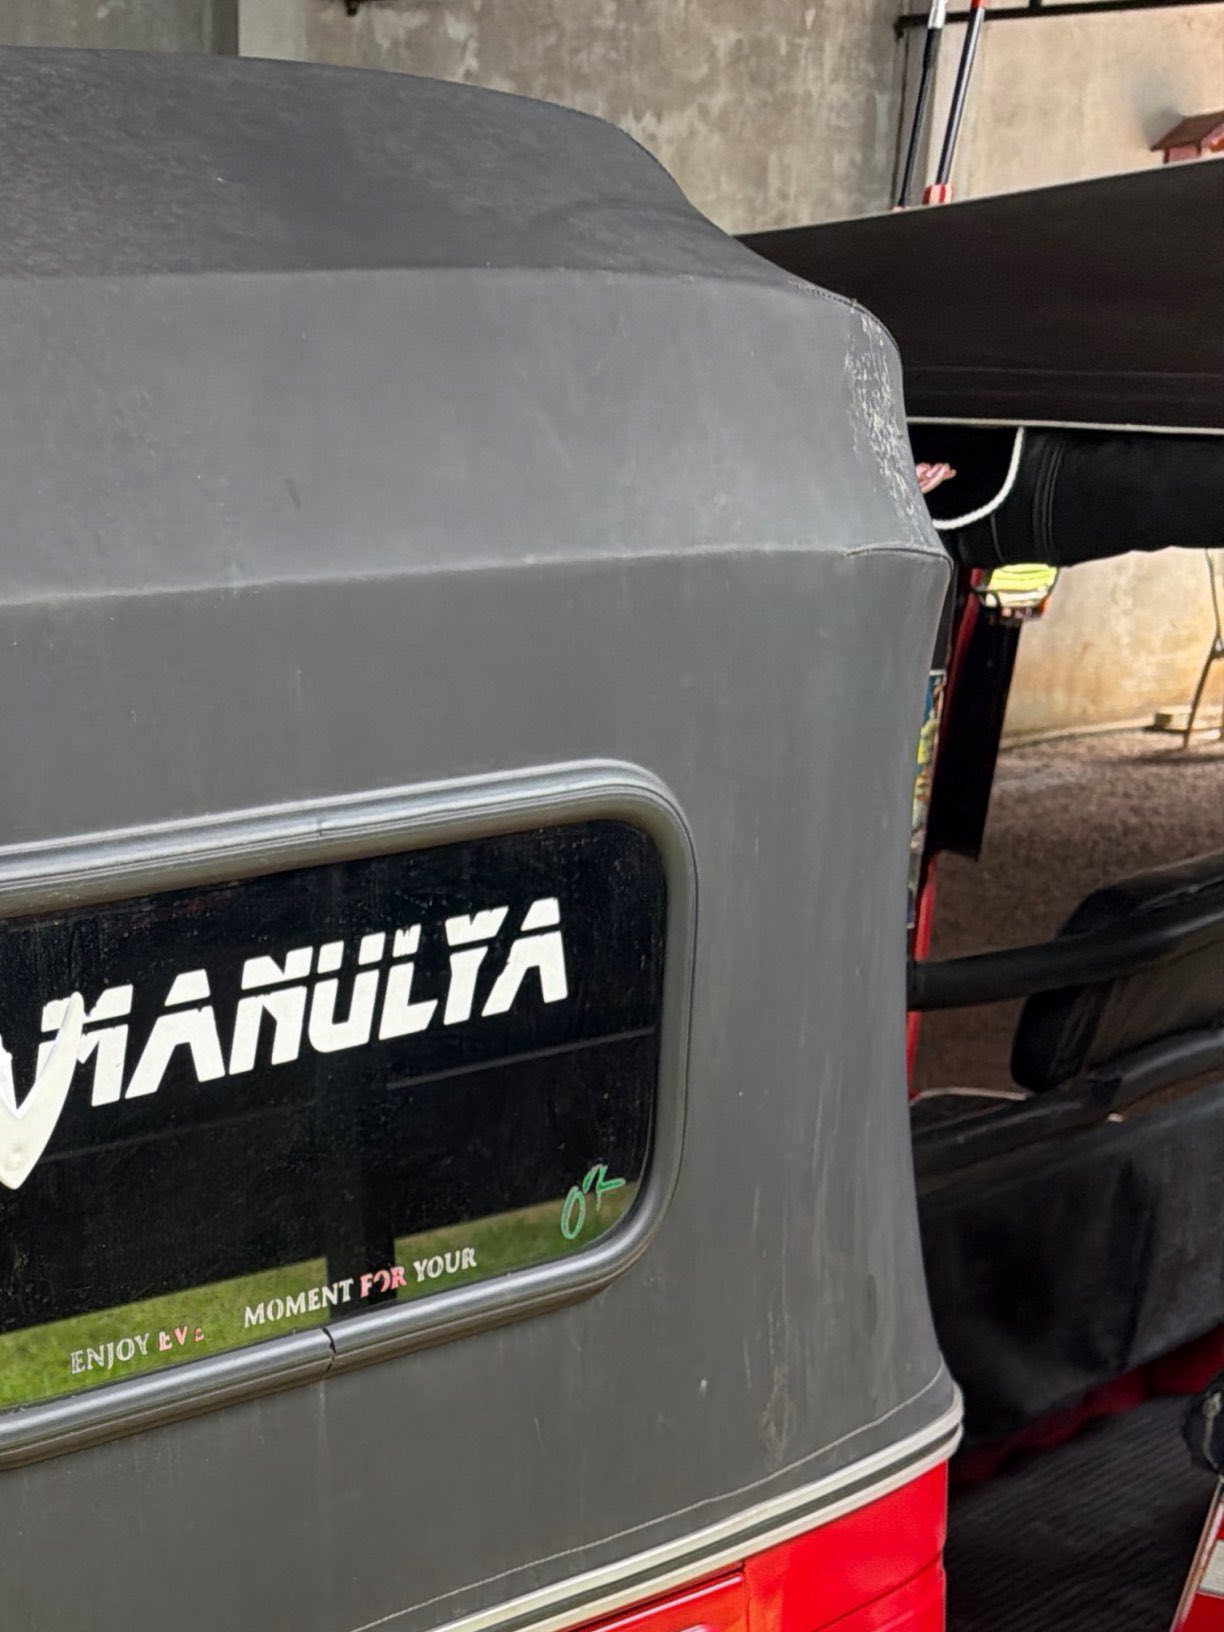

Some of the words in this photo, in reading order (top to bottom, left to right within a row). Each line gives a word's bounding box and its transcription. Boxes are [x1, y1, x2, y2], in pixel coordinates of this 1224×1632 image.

[70, 1332, 151, 1375] ENJOY
[243, 1277, 355, 1329] MOMENT
[359, 1265, 408, 1298] FOR
[413, 1247, 478, 1282] YOUR
